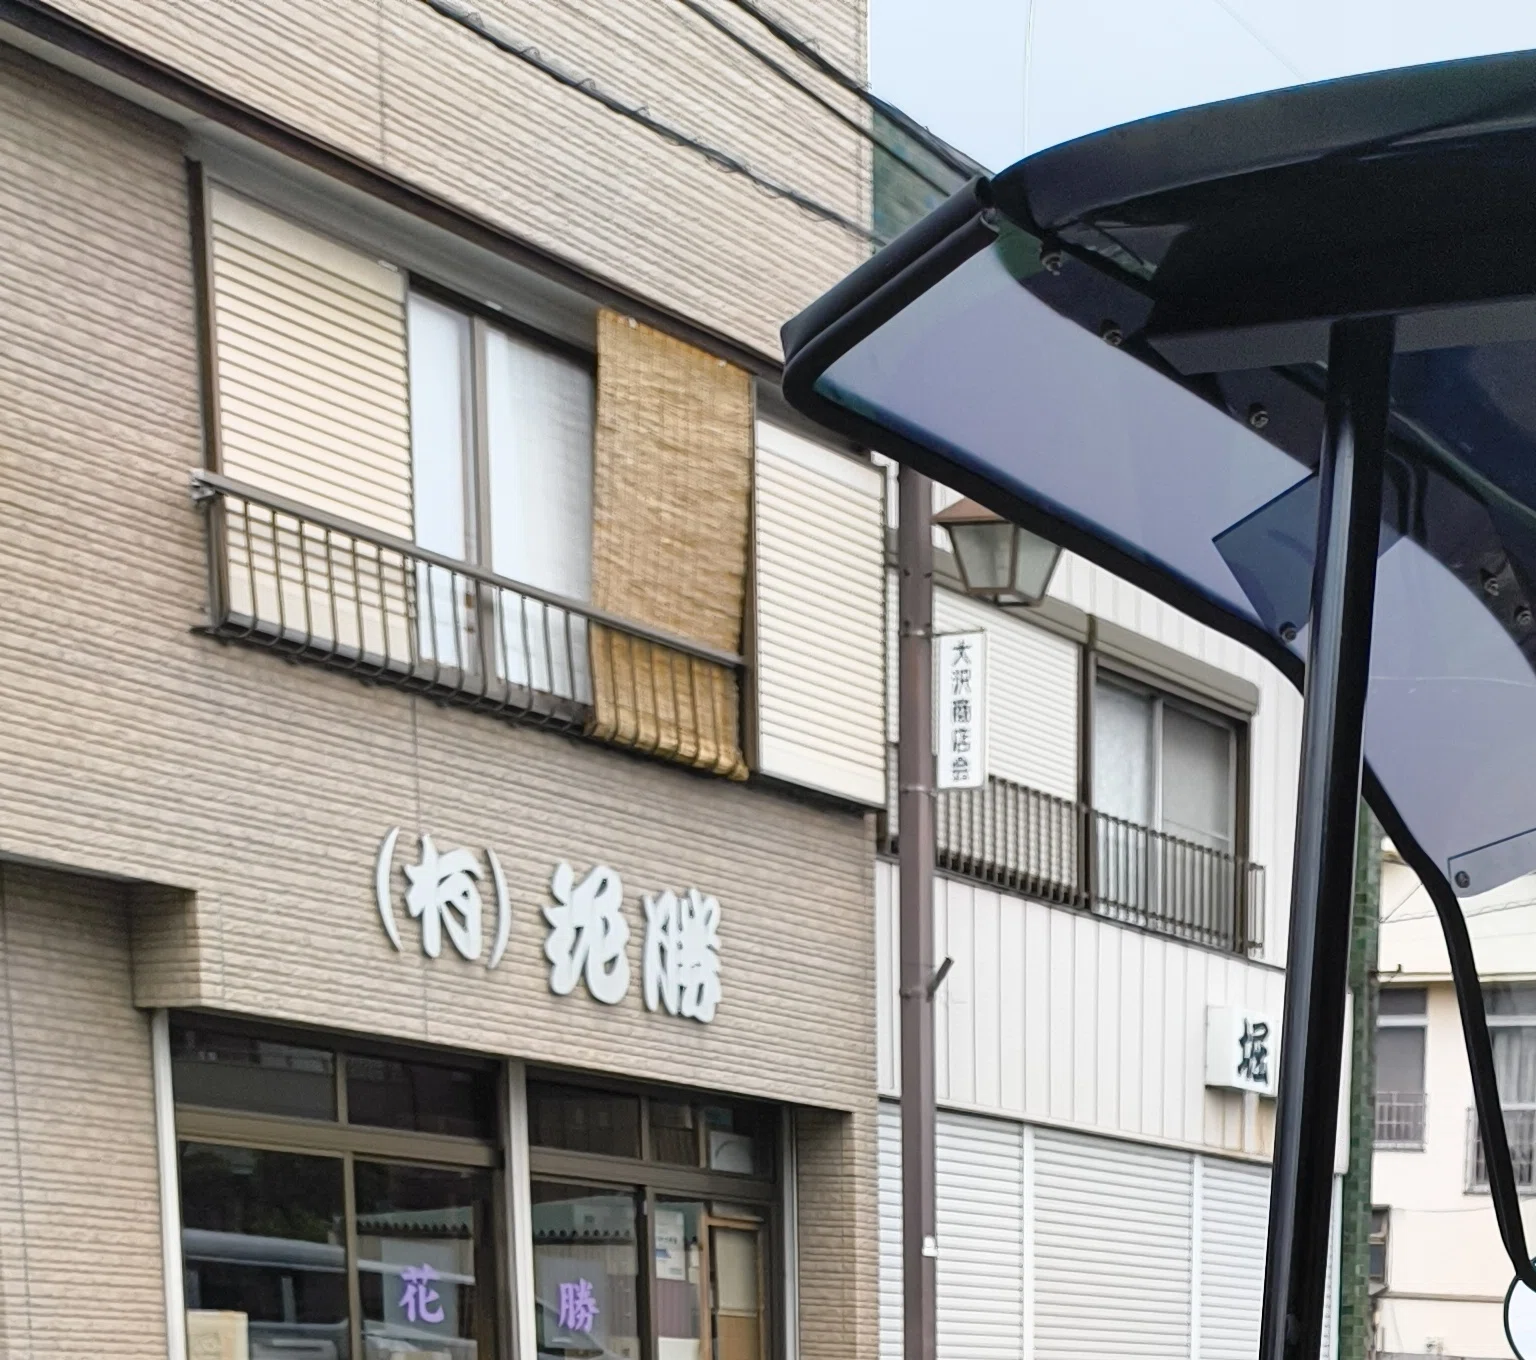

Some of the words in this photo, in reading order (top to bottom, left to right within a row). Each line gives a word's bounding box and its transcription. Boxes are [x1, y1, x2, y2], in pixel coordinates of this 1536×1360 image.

[952, 639, 972, 781] 大沢商店会
